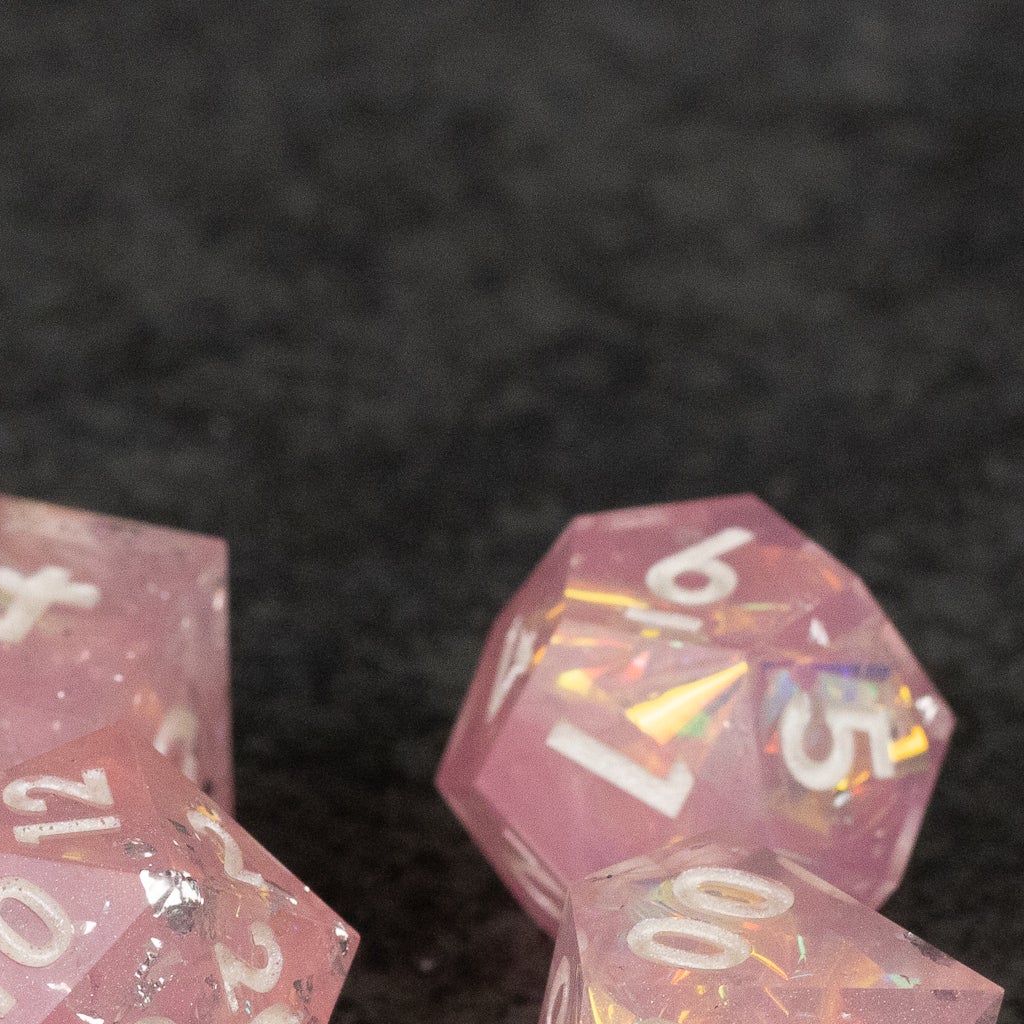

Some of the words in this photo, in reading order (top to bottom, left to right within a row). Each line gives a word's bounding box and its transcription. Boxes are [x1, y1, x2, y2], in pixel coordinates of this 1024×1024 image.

[780, 694, 898, 793] 5
[2, 767, 122, 845] 12
[626, 866, 796, 970] 00
